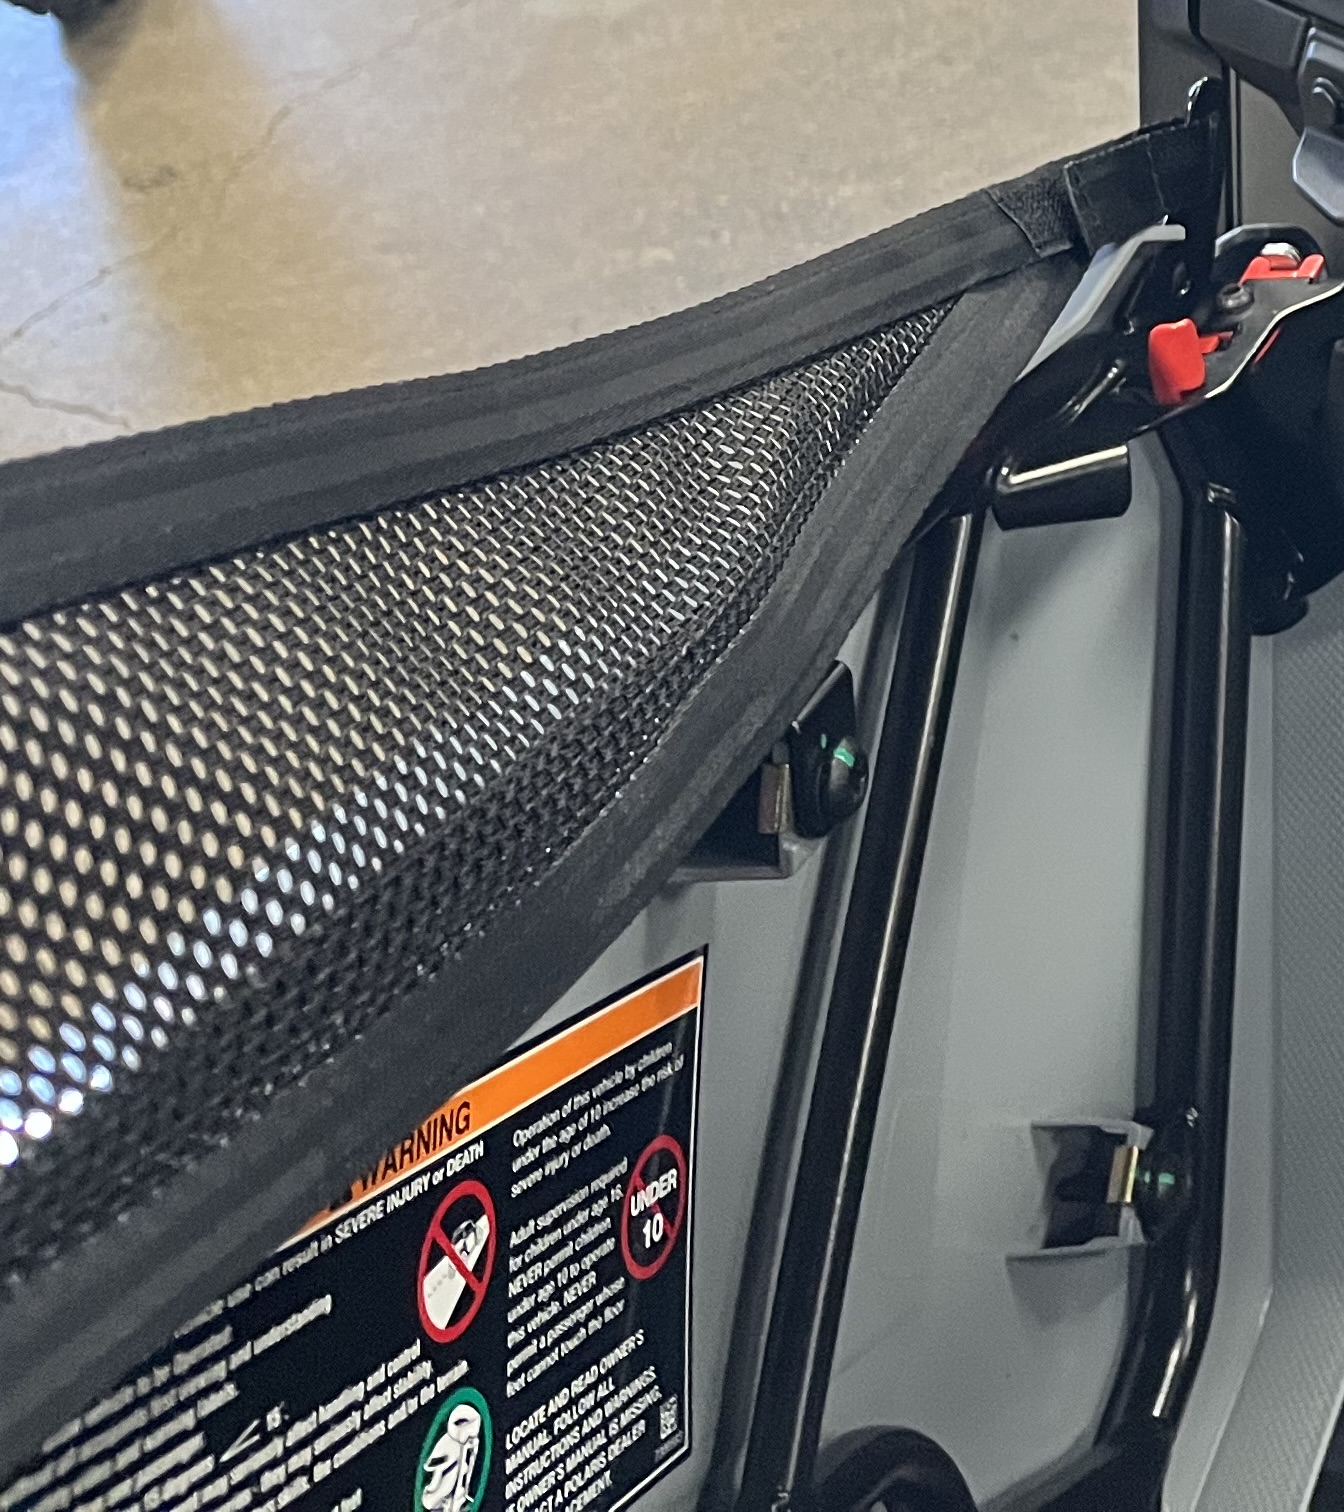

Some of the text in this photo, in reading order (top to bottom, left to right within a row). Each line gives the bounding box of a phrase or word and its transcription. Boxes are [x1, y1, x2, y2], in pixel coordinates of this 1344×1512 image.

[512, 1145, 540, 1172] under
[559, 1123, 577, 1143] age
[578, 1111, 588, 1131] of
[513, 1109, 560, 1147] Operation
[562, 1098, 572, 1118] of
[320, 1234, 332, 1253] in
[334, 1200, 385, 1243] SEVERE
[386, 1172, 430, 1214] INJURY
[432, 1168, 445, 1185] or
[446, 1140, 484, 1177] DEATH
[630, 1168, 678, 1217] UNDER
[510, 1219, 535, 1248] Adult
[524, 1228, 562, 1262] children
[563, 1208, 590, 1235] under
[591, 1196, 609, 1216] age
[642, 1212, 664, 1249] 10
[508, 1262, 542, 1297] NEVER
[563, 1271, 597, 1306] NEVER
[505, 1329, 645, 1450] LOCATE AND READ OWNER'S
[553, 1390, 595, 1435] FOLLOW
[597, 1377, 615, 1401] ALL
[505, 1426, 581, 1500] INSTRUCTIONS
[582, 1408, 604, 1437] AND
[517, 1463, 565, 1512] OWNER'S
[565, 1429, 608, 1473] MANUAL
[608, 1418, 619, 1437] IS
[555, 1489, 563, 1507] A
[564, 1451, 607, 1498] POLARIS
[608, 1419, 646, 1461] DEALER
